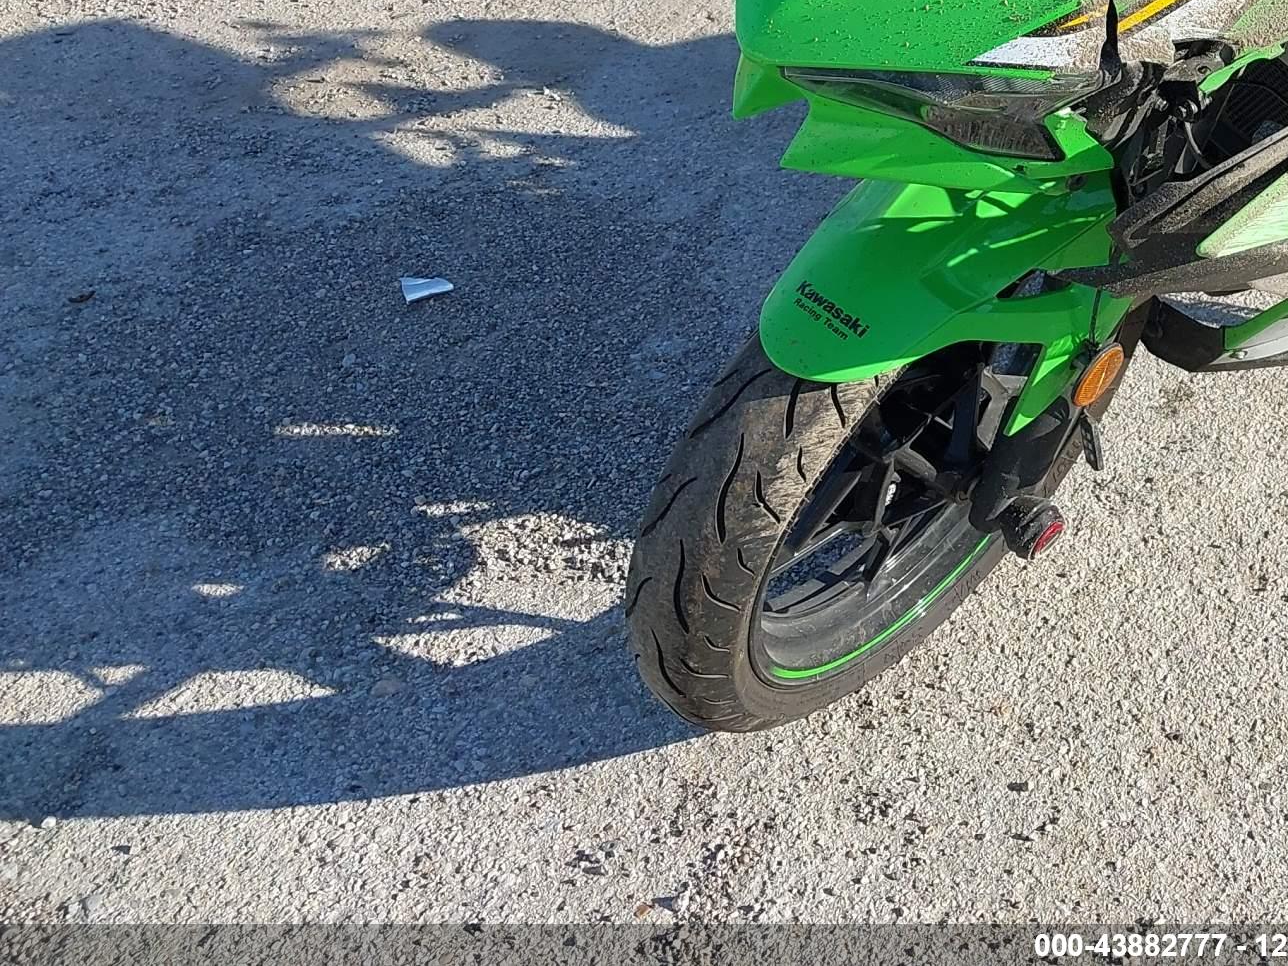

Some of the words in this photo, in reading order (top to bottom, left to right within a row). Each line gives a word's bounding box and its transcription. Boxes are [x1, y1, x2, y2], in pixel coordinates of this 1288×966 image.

[793, 297, 822, 322] Racing
[823, 317, 849, 340] Team
[796, 280, 870, 338] Kawasaki
